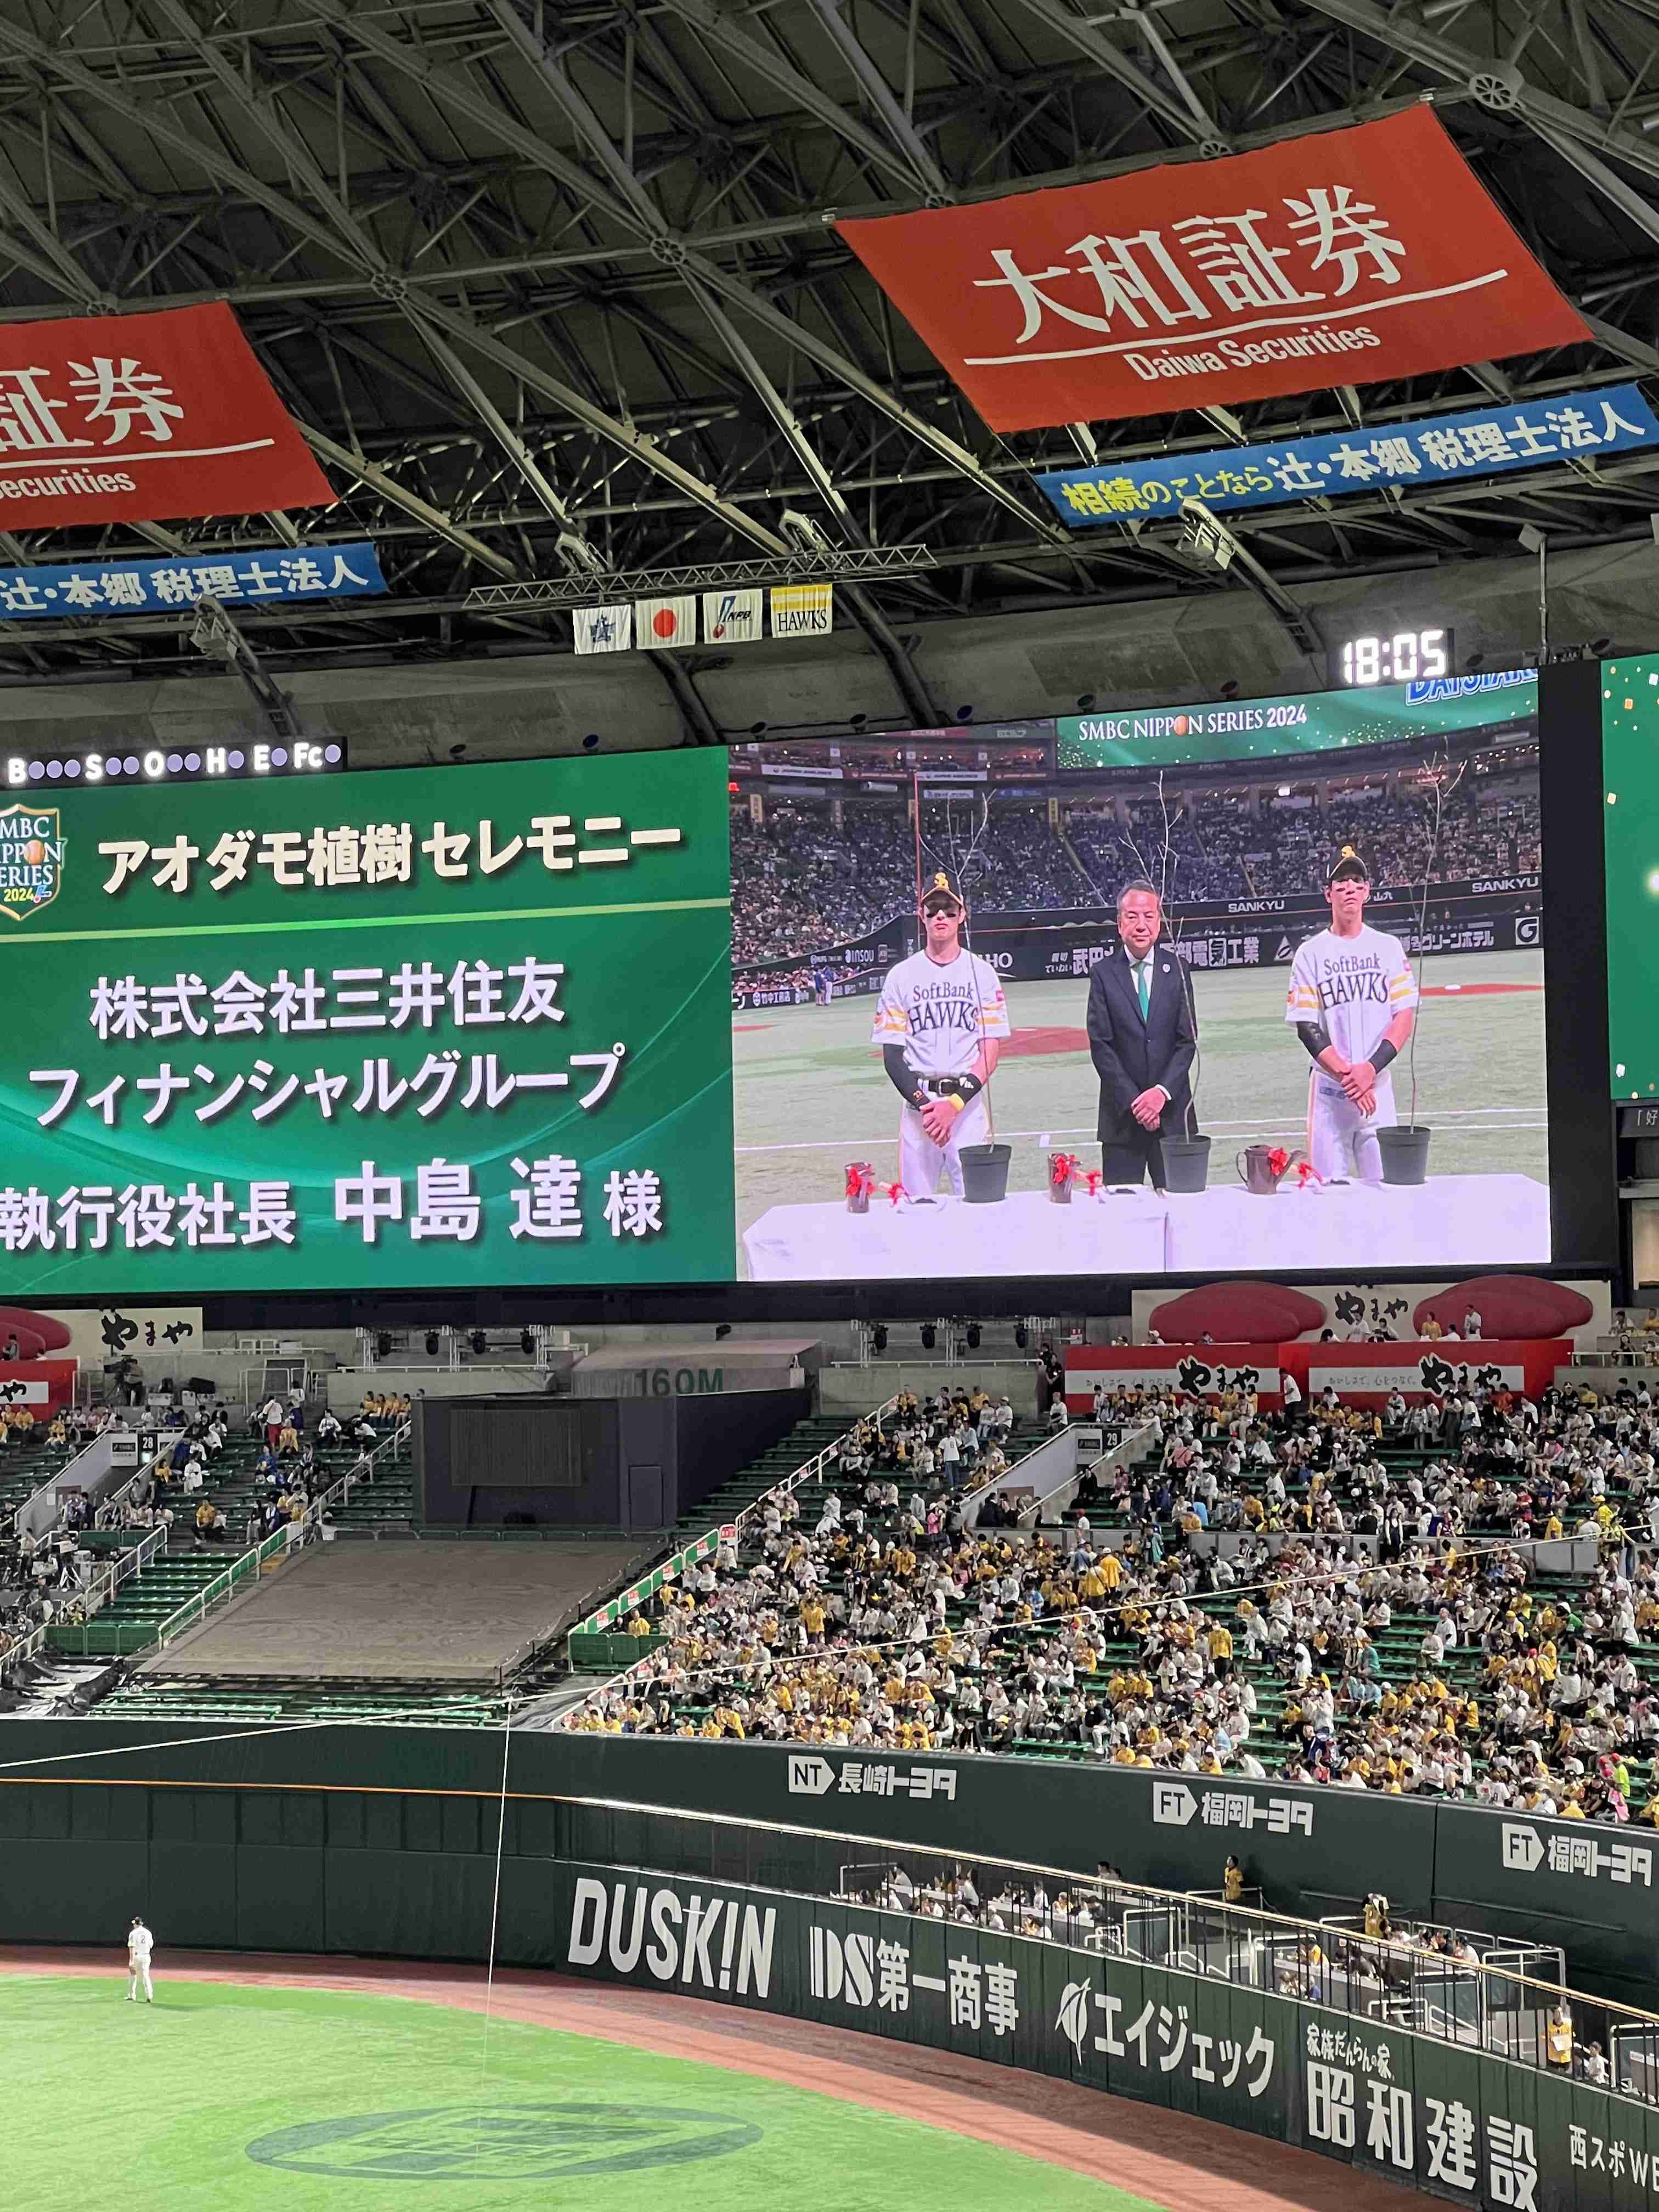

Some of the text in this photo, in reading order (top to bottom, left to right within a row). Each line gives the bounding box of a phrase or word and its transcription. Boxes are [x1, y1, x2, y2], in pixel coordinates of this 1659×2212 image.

[973, 184, 1407, 344] 大和証券
[1123, 324, 1381, 381] Daiwa Securities
[1421, 400, 1646, 470] 税理士法人
[0, 469, 136, 500] ecurities
[150, 555, 369, 604] 税理士法人
[778, 610, 827, 631] HAWKS
[1344, 630, 1446, 684] 18:05
[1079, 719, 1130, 741] SMBC
[1207, 710, 1263, 733] SERIES
[1267, 704, 1307, 727] 2024
[8, 742, 323, 783] B S O H E FC
[0, 816, 50, 839] MBC
[98, 816, 681, 895] アオダモ植樹 セレモニー
[0, 865, 54, 887] ERIES
[3, 888, 34, 902] 2024
[1472, 877, 1538, 893] SANKYU
[1228, 900, 1285, 913] SANKYU
[1324, 953, 1381, 976] SoftBank
[89, 956, 566, 1040] 株式会社三井住友
[913, 981, 974, 1001] SoftBank
[1318, 972, 1388, 1010] HAWKS
[908, 1001, 978, 1036] HAWKS
[29, 1042, 625, 1127] フィナンシャルグループ
[0, 1154, 663, 1251] 執行役社長 中島 達 様
[1335, 1290, 1409, 1325] やまや
[101, 1309, 193, 1351] やまや
[1178, 1358, 1260, 1396] やまや
[143, 1437, 154, 1449] 28
[1107, 1432, 1118, 1446] 29
[794, 1763, 957, 1801] NT 長崎トヨタ
[1160, 1791, 1314, 1837] FT 福岡トヨタ
[1510, 1833, 1652, 1887] FT 福岡トヨタ
[877, 1938, 1020, 2036] 第一商事
[1094, 1992, 1274, 2098] エイジェック
[1307, 2061, 1537, 2212] 昭和建設
